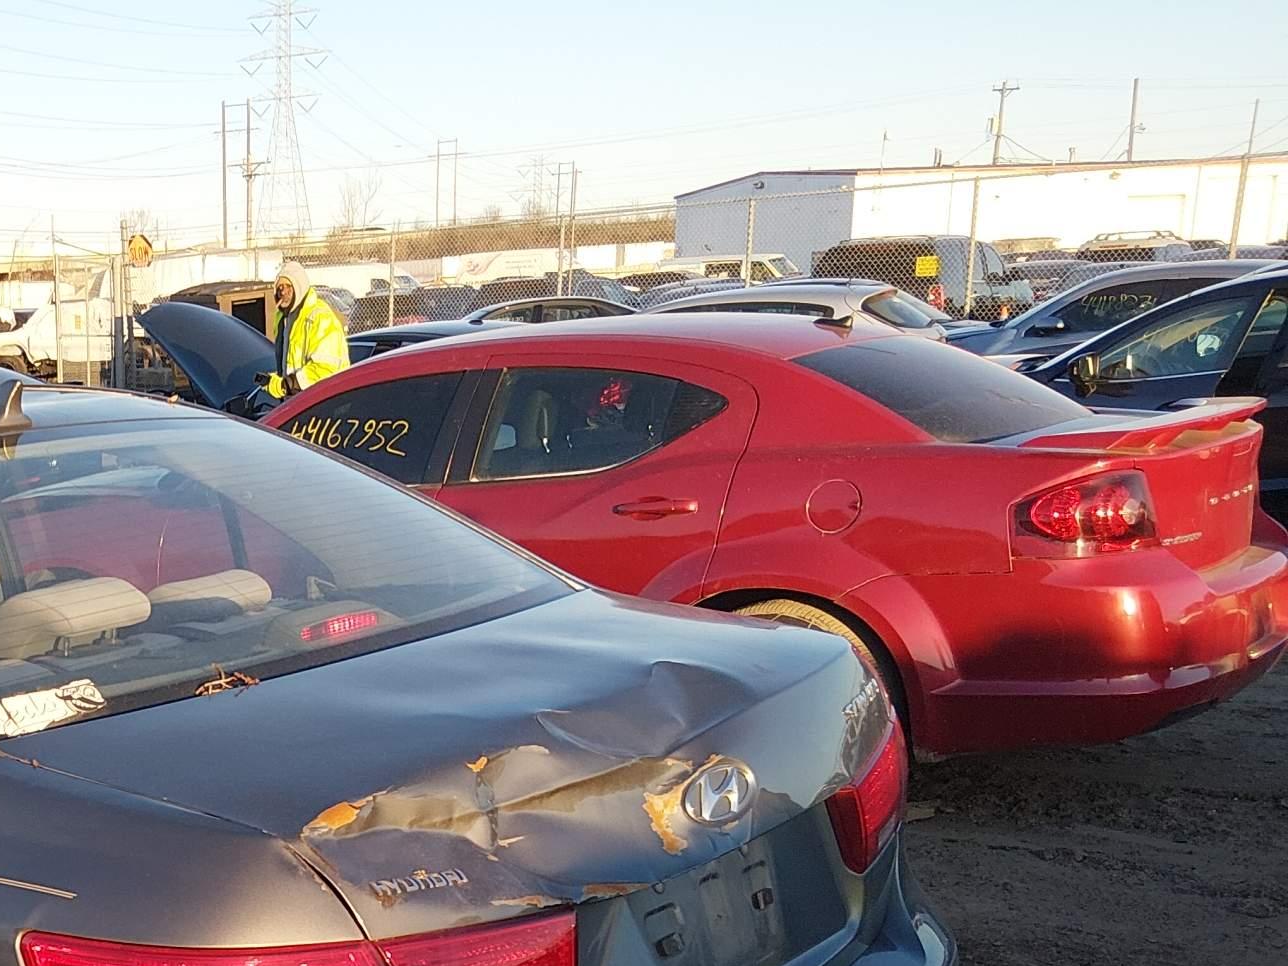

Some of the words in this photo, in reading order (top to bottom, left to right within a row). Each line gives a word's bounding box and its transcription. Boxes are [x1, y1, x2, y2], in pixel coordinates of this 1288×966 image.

[129, 246, 150, 262] SLOW
[291, 416, 410, 457] 44167952
[369, 867, 470, 897] HYUNDAI
